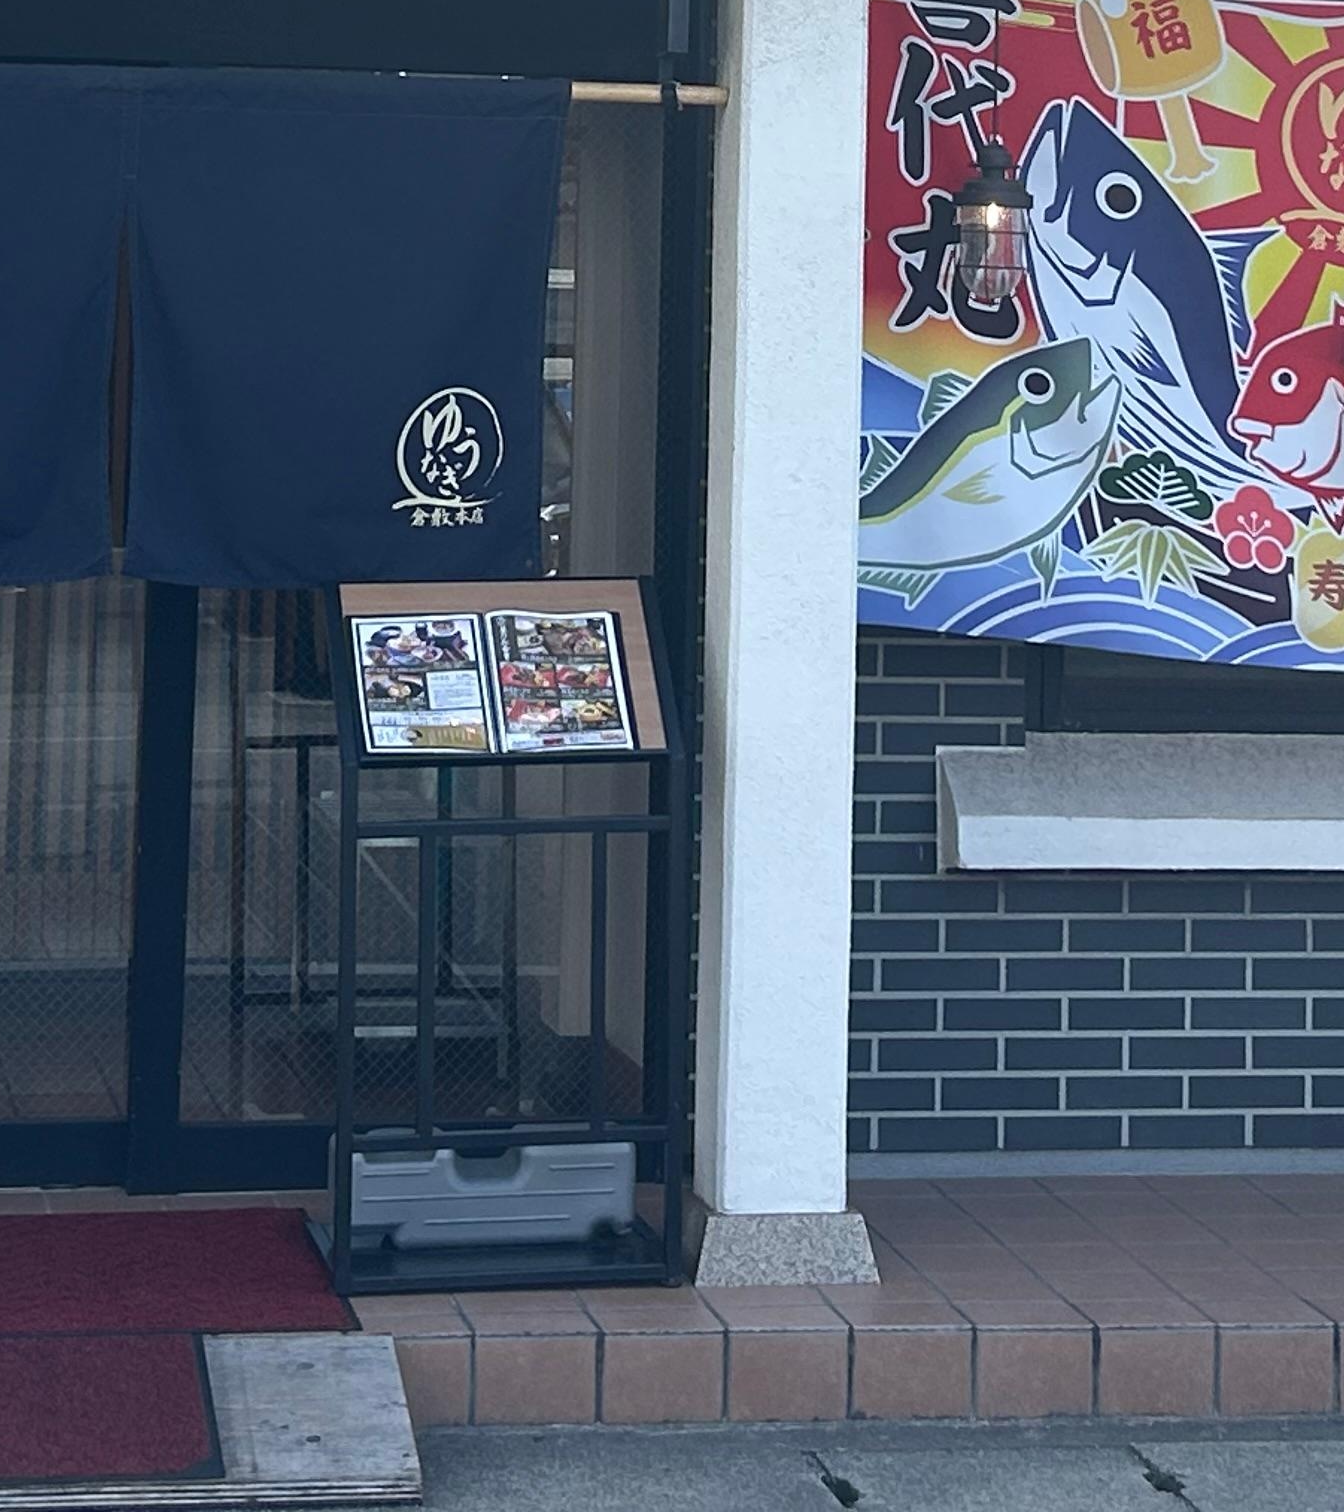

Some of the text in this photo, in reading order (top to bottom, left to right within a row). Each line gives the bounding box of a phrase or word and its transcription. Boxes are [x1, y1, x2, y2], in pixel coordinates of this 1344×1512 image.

[420, 393, 482, 496] ゆうなぎ
[410, 506, 485, 528] 倉敷本店
